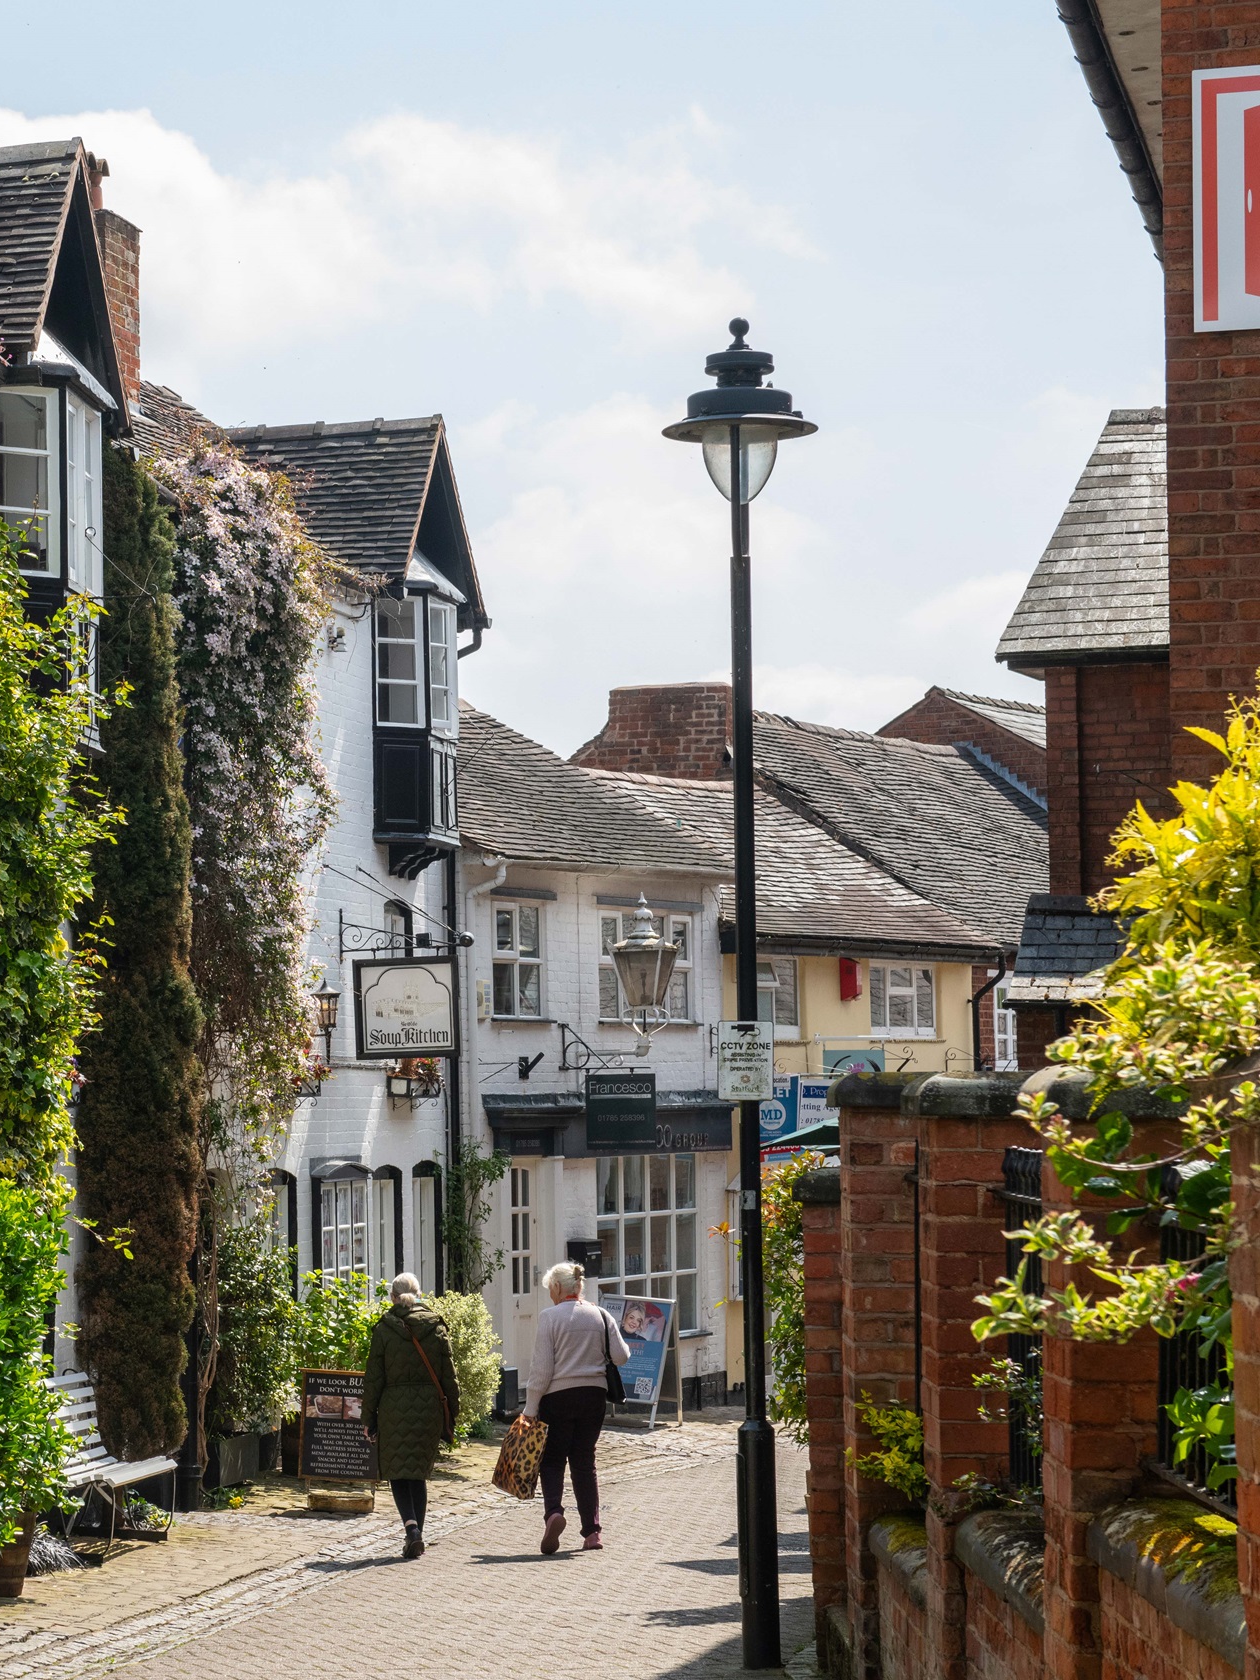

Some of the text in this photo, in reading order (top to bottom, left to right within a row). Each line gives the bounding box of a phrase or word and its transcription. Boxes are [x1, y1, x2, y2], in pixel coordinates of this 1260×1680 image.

[369, 1027, 449, 1047] Soup Kitchen
[720, 1042, 771, 1050] CCTV ZONE
[589, 1081, 652, 1094] Francesco
[773, 1087, 791, 1098] ET
[760, 1109, 783, 1120] MD
[675, 1133, 709, 1148] GROUP
[349, 1377, 364, 1387] BU
